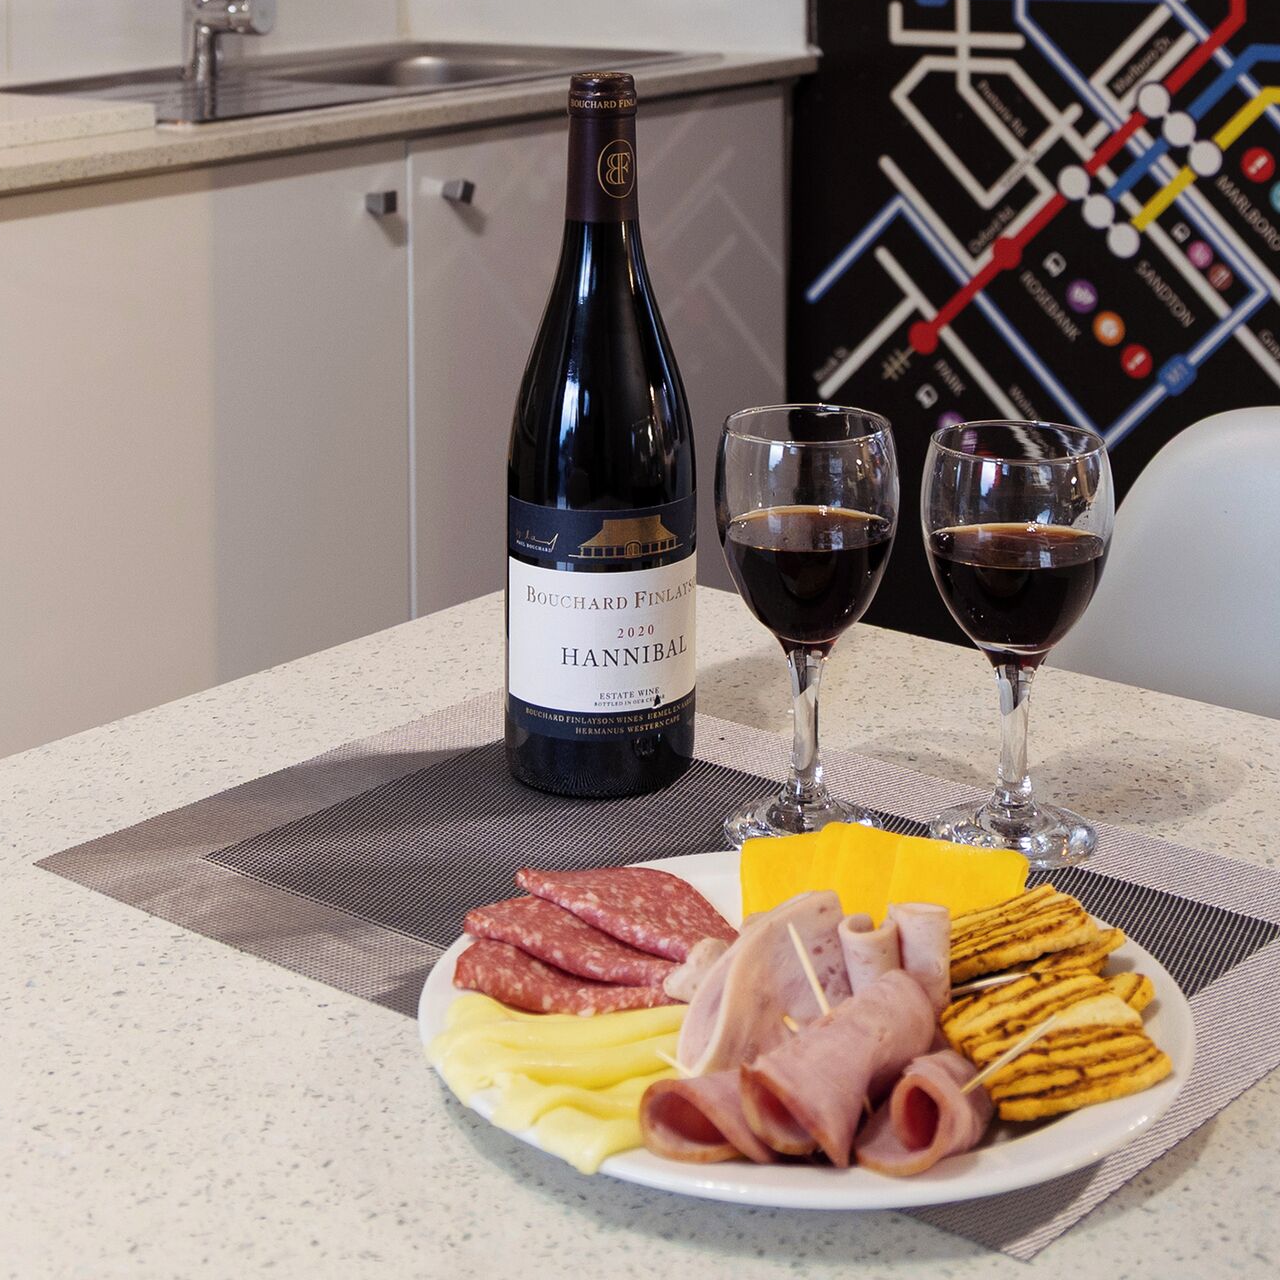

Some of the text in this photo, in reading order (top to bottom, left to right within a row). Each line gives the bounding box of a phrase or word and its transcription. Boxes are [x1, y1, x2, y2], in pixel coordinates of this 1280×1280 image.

[570, 99, 617, 109] BOUCHARD
[1135, 259, 1196, 328] SANDTON
[1020, 270, 1081, 342] ROSEBANK
[934, 359, 965, 397] PARK
[526, 585, 628, 611] BOUCHARD
[617, 624, 655, 639] 2020
[561, 634, 688, 668] HANNIBAL
[599, 686, 660, 701] ESTATE WINE
[526, 707, 565, 722] BOUCHARD
[566, 715, 615, 725] FINLAYSON
[617, 714, 644, 724] WINES
[647, 705, 672, 720] HEMEL
[575, 726, 625, 736] HERMANUS
[627, 719, 664, 733] WESTERN
